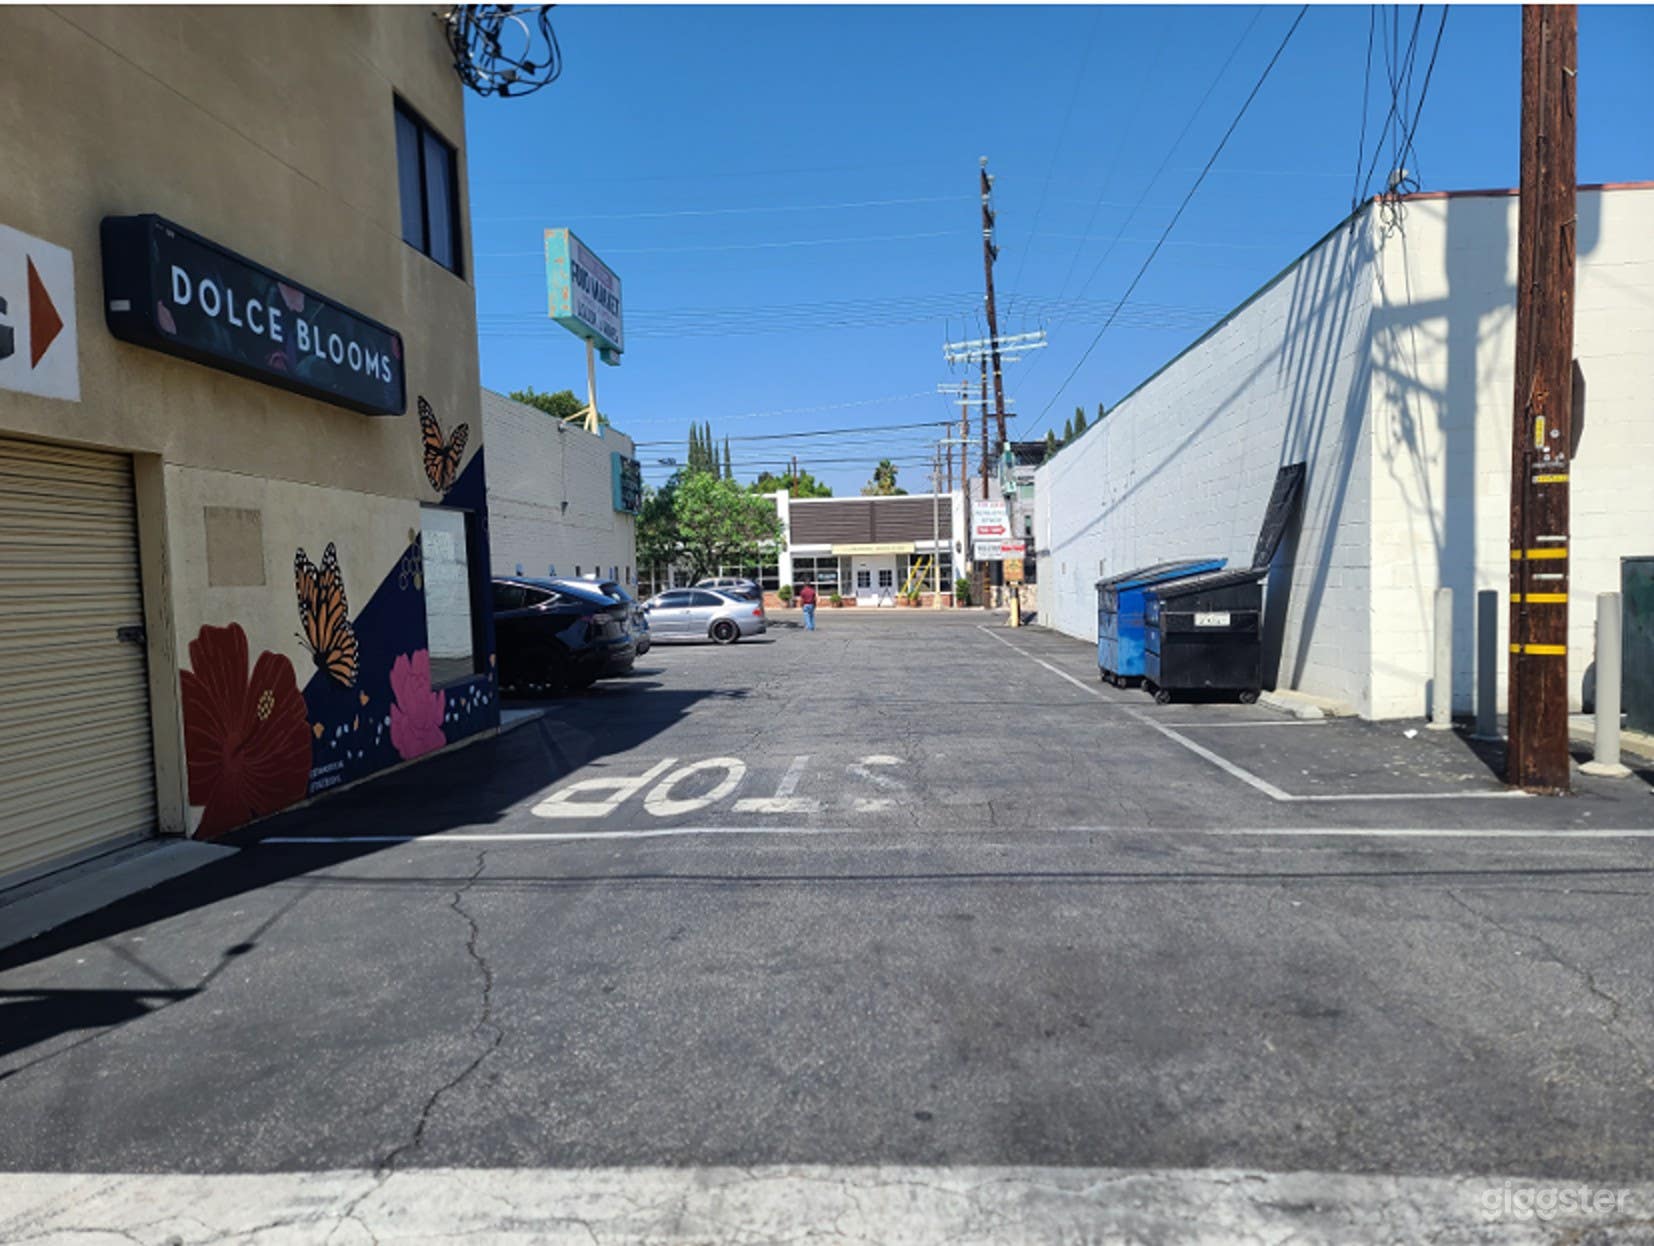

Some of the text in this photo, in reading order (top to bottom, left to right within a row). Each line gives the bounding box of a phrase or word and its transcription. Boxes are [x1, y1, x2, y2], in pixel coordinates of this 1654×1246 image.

[171, 265, 393, 384] DOLCE BLOOMS
[530, 754, 905, 818] STOP
